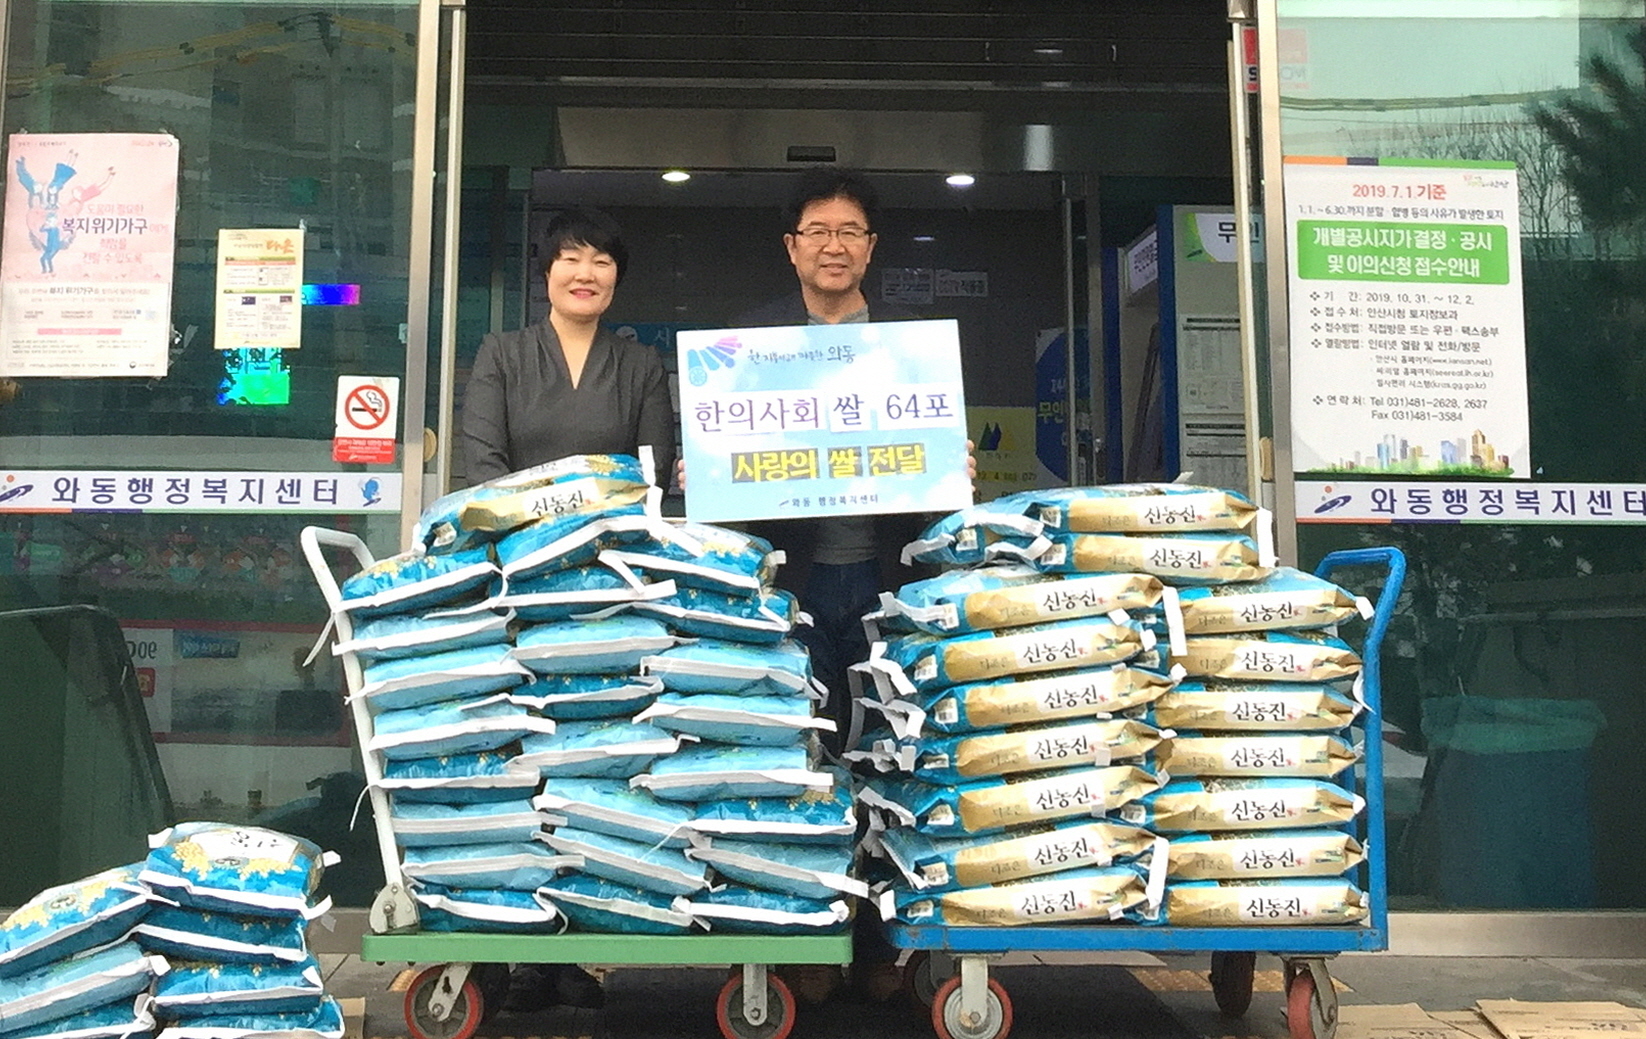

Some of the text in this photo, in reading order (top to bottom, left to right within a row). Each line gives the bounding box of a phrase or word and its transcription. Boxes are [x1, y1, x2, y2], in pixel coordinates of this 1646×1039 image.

[1411, 208, 1429, 219] 등의
[1430, 208, 1457, 219] 사유가
[1459, 209, 1485, 220] 발생한
[1486, 209, 1504, 220] 토지
[1413, 230, 1447, 250] 결정
[1459, 232, 1493, 251] 공시
[1328, 255, 1480, 278] 및 이의신청 접수안내
[1367, 308, 1406, 319] 안산시청
[1409, 309, 1458, 320] 토지정보과
[1410, 325, 1429, 335] 또는
[827, 345, 856, 364] 와동
[1368, 339, 1397, 350] 인터넷
[1400, 340, 1420, 351] 열람
[1424, 341, 1434, 351] 및
[694, 392, 954, 432] 한의사회 쌀 64포
[1370, 396, 1384, 406] Tel
[1464, 398, 1488, 408] 2637
[1371, 410, 1388, 420] Fax
[734, 443, 925, 482] 사랑의 쌀 전달
[51, 476, 338, 505] 와동행정복지센터
[1371, 487, 1646, 516] 와동행정복지센터
[1150, 548, 1201, 569] 신동진
[1241, 650, 1295, 674] 신동진
[1232, 701, 1286, 722] 신동진
[1246, 897, 1300, 919] 신동진
